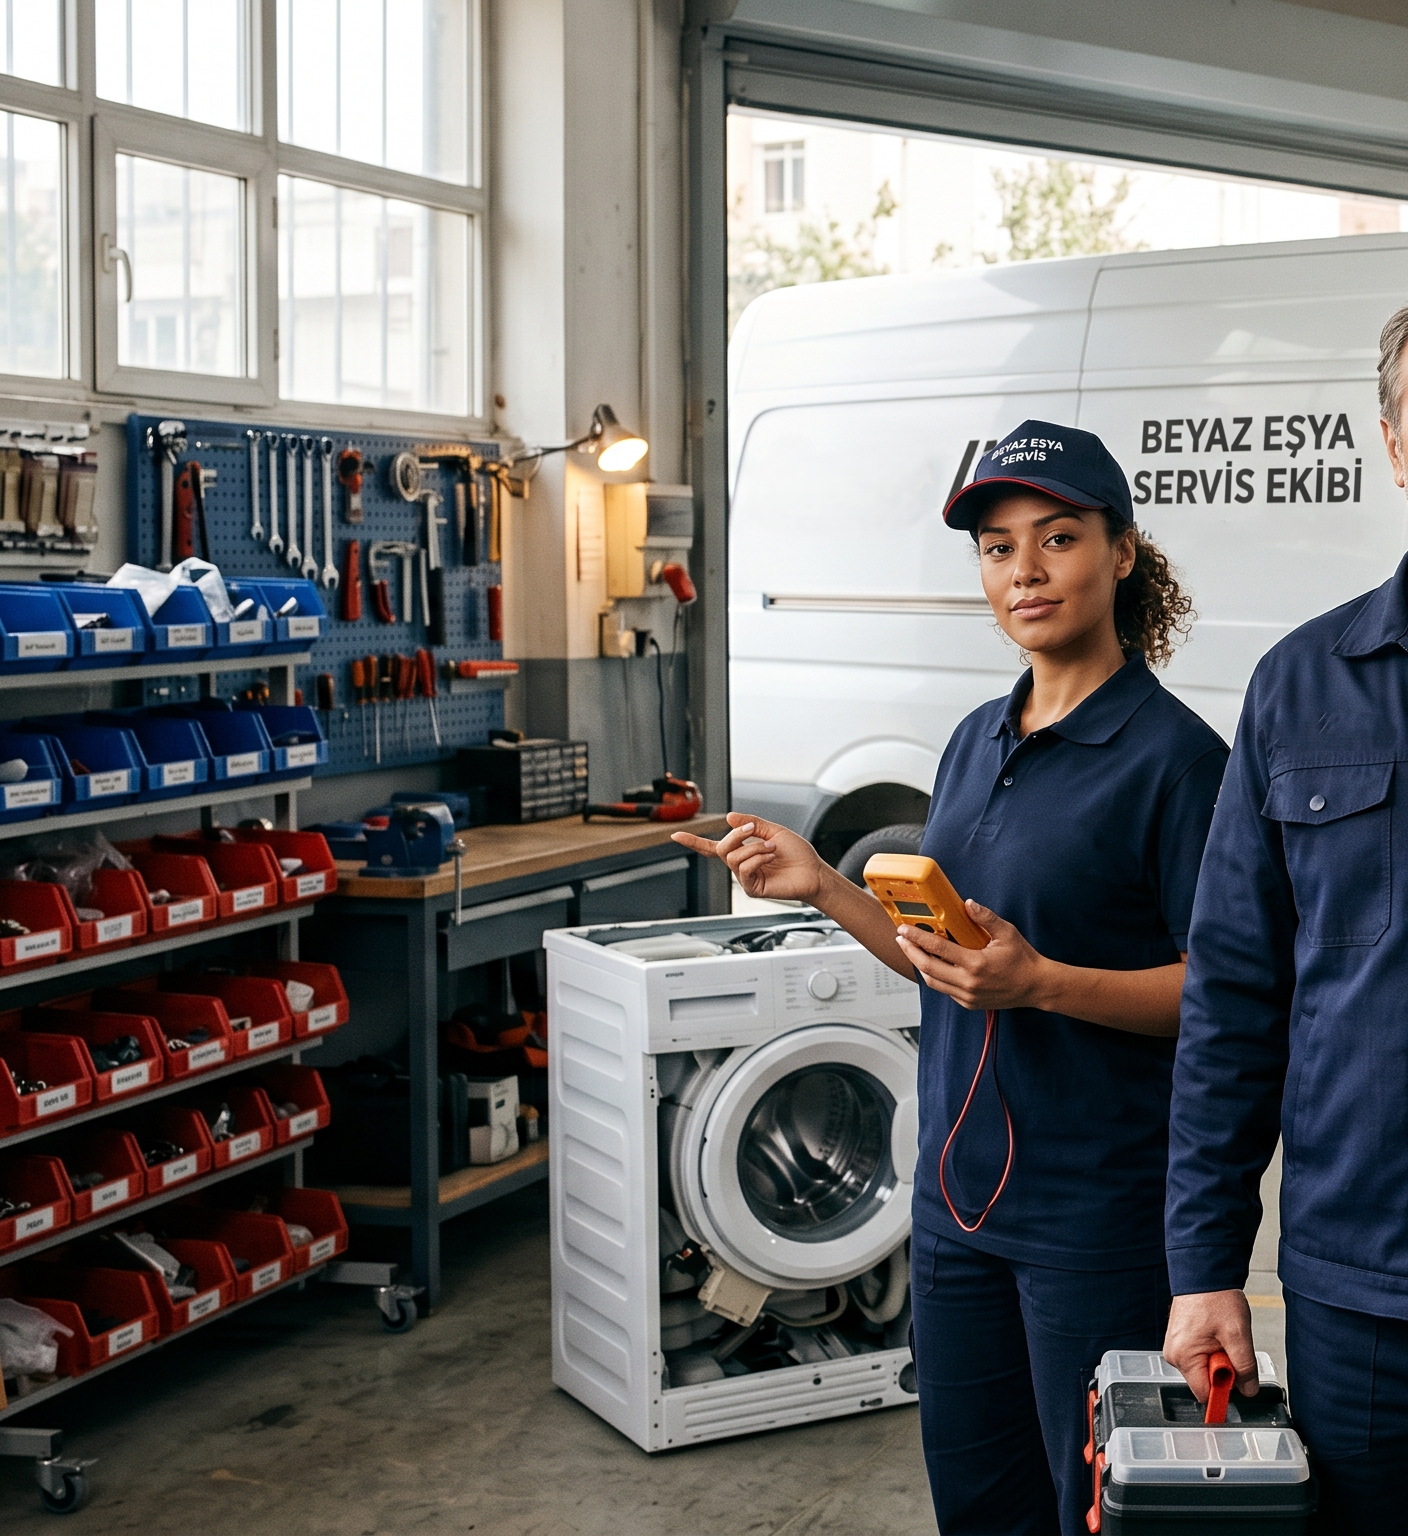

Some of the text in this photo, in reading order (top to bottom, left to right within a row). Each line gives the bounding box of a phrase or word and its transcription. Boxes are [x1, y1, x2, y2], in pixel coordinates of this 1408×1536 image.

[1000, 449, 1047, 466] SERVİS
[1141, 413, 1355, 459] BEYAZ EŞYA
[1133, 458, 1362, 505] SERVİS EKİBİ
